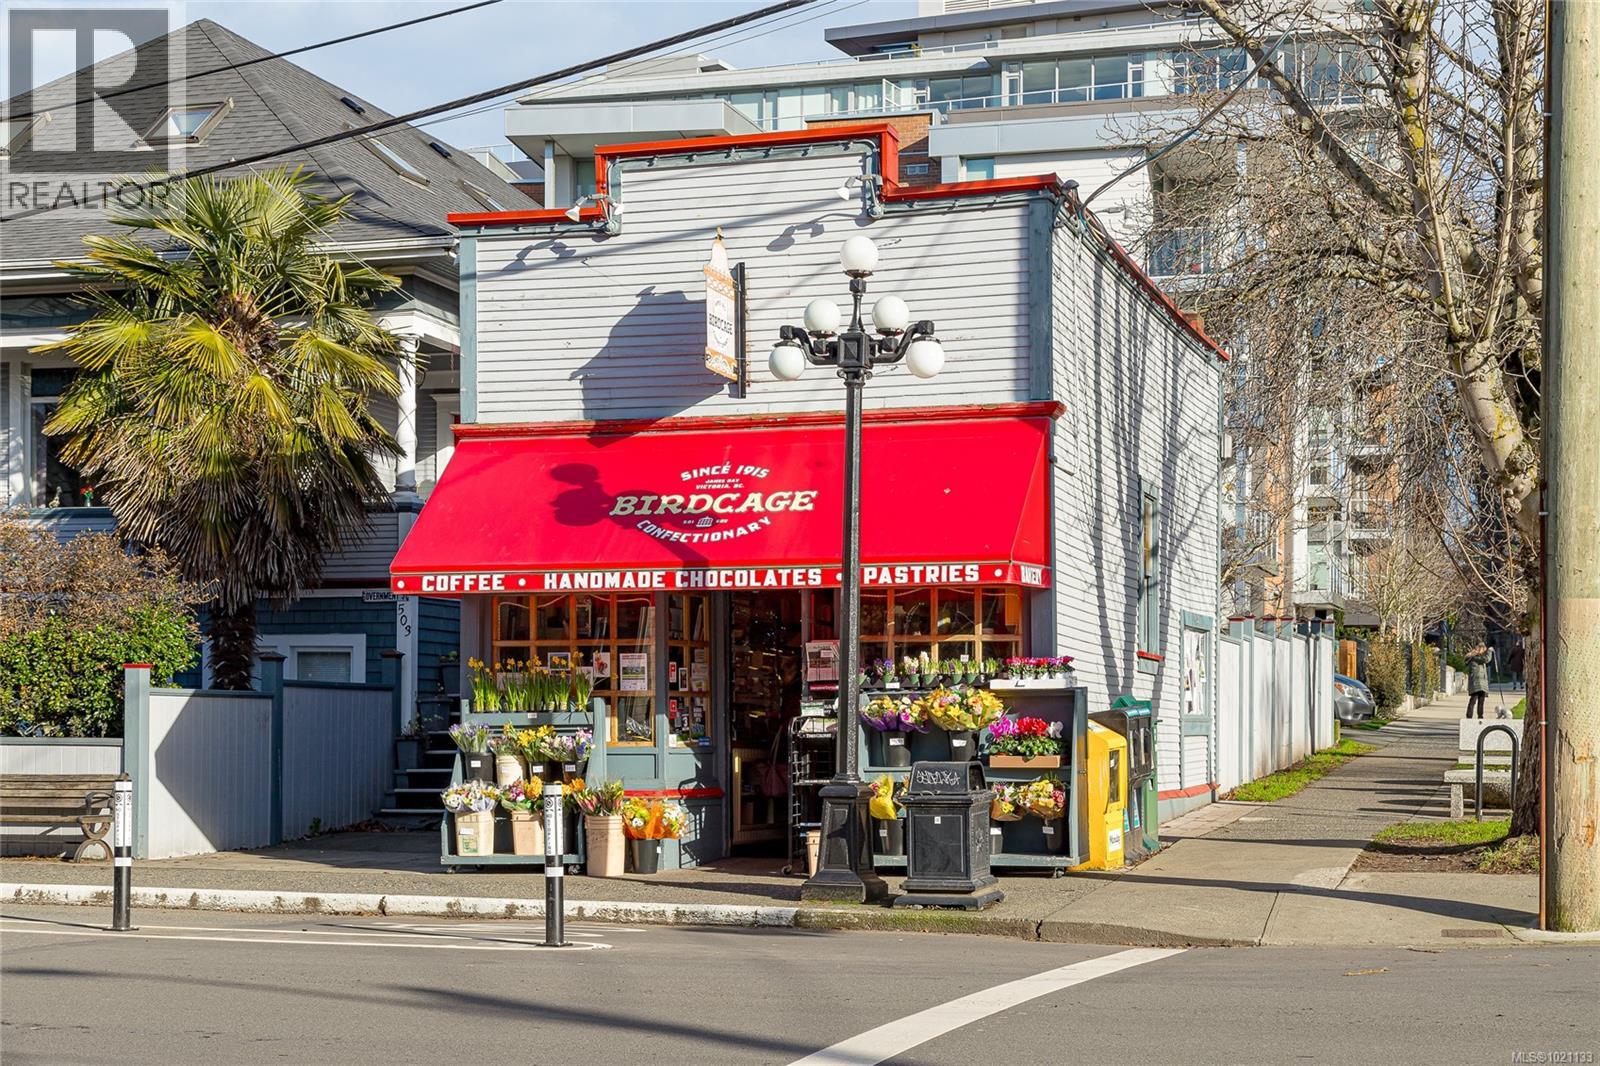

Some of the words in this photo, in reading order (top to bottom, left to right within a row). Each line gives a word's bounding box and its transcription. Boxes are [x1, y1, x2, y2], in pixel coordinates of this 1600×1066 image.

[736, 465, 770, 479] 1915
[608, 490, 818, 516] BIRDCAGE
[636, 516, 772, 544] CONFECTIONARY
[421, 574, 506, 592] COFFEE
[543, 571, 666, 590] HANDMADE
[675, 568, 822, 589] CHOCOLATES
[863, 565, 980, 584] PASTRIES
